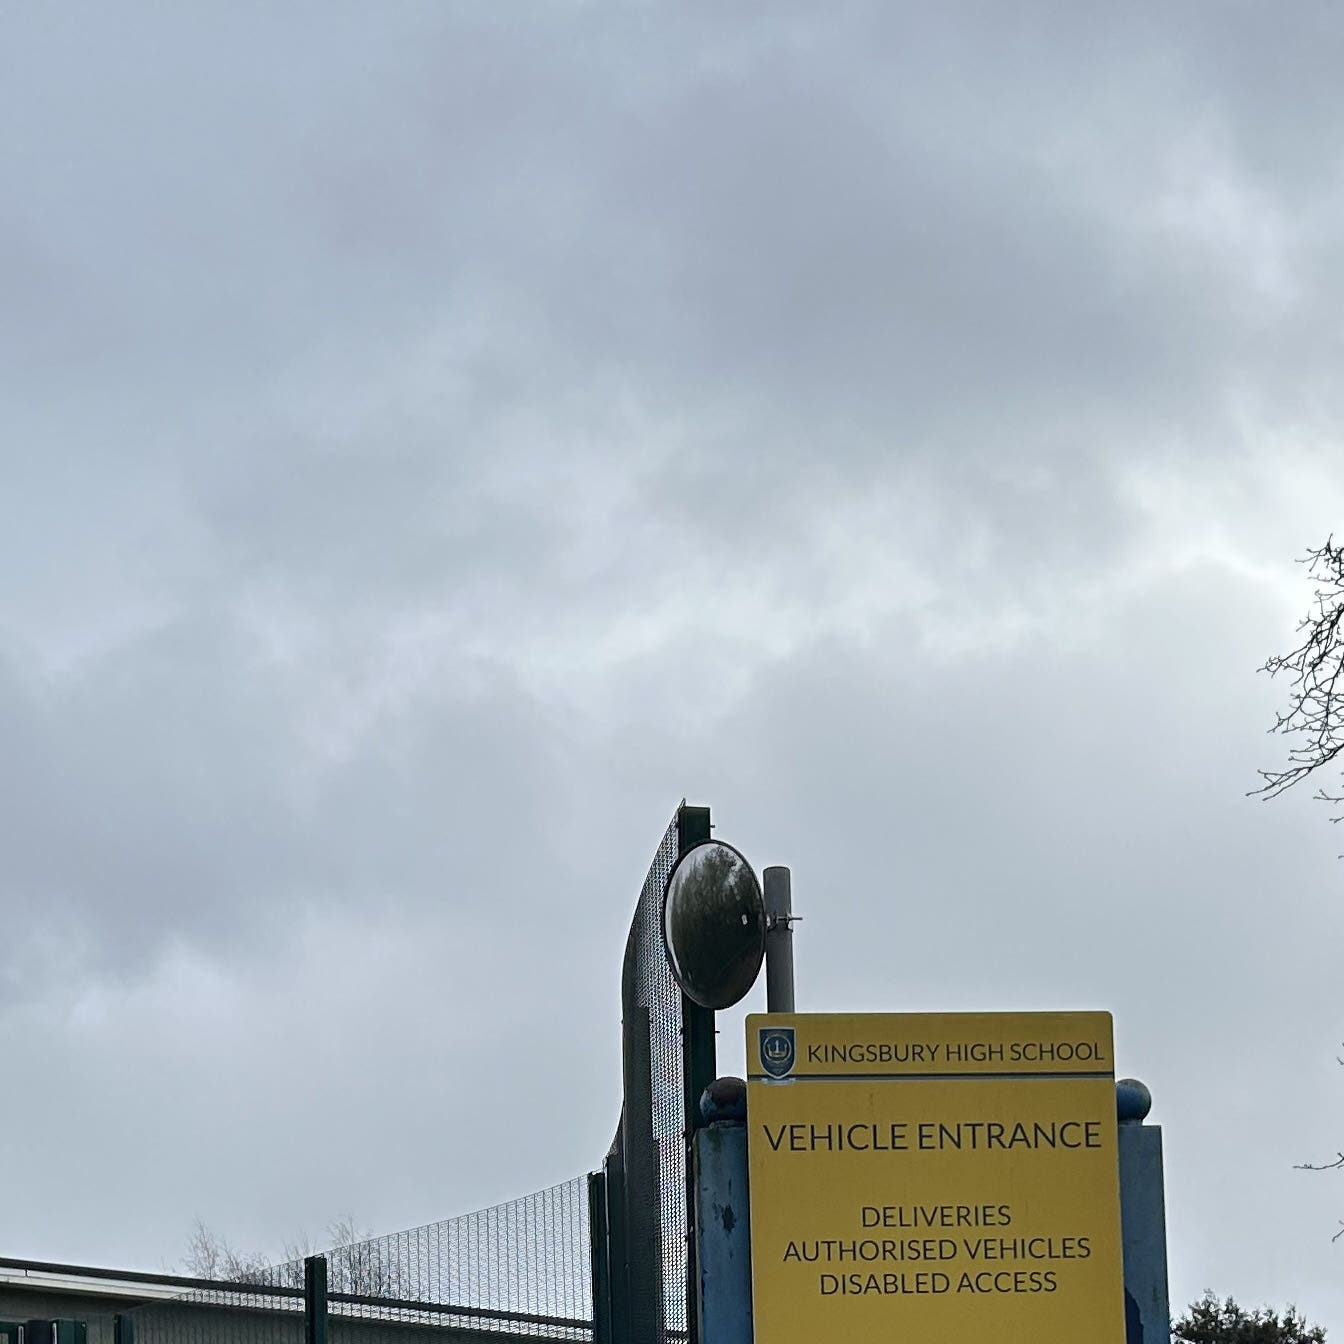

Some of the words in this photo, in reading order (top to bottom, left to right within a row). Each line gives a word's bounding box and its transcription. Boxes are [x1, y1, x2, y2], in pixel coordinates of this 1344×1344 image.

[808, 1043, 940, 1063] KINGSBURY
[946, 1043, 1004, 1062] HIGH
[1010, 1042, 1105, 1061] SCHOOL
[763, 1123, 909, 1151] VEHICLE
[918, 1121, 1102, 1150] ENTRANCE
[861, 1205, 1011, 1228] DELIVERIES
[783, 1239, 956, 1262] AUTHORISED
[963, 1237, 1091, 1260] VEHICLES
[820, 1273, 950, 1295] DISABLED
[956, 1271, 1057, 1294] ACCESS
